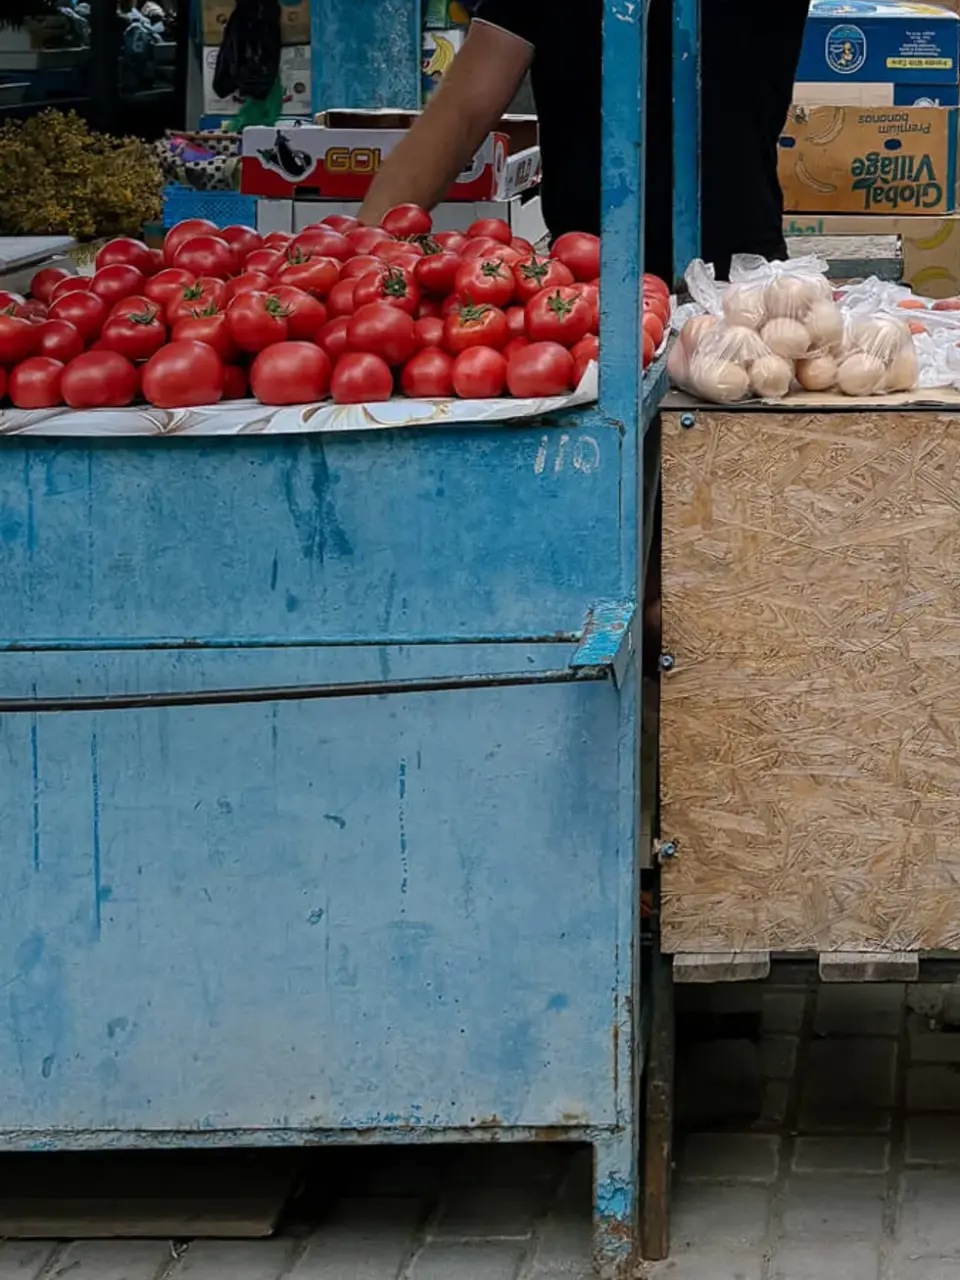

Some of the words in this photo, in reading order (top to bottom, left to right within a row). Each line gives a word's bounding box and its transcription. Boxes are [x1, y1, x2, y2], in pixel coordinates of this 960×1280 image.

[858, 113, 909, 124] bananas
[878, 122, 932, 134] Premium
[851, 152, 937, 182] Village
[852, 179, 943, 210] Global
